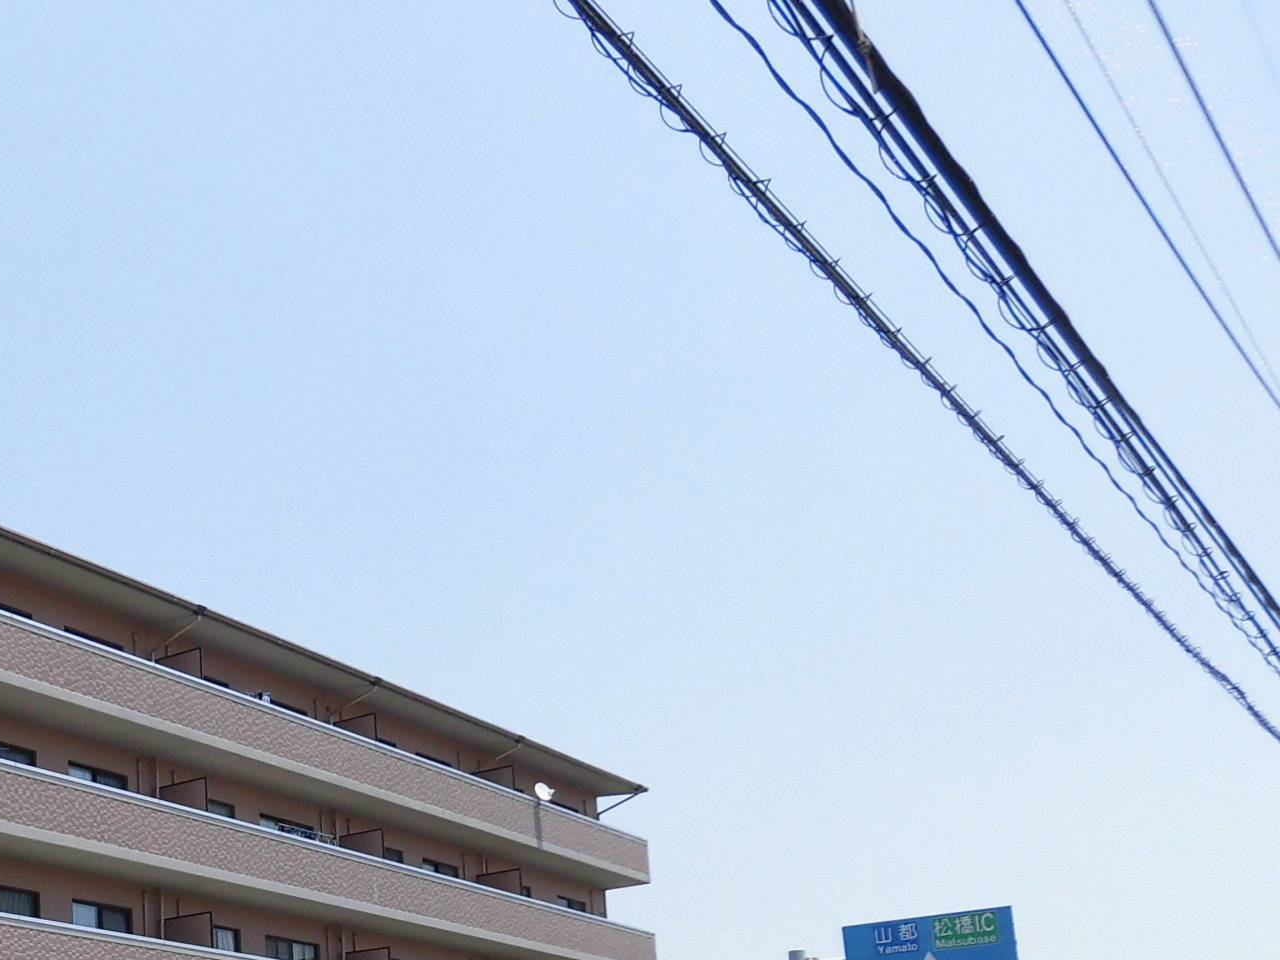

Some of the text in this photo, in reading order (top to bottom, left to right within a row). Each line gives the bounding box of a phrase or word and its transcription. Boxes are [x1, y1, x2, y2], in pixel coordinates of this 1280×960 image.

[874, 923, 918, 944] 山都
[934, 913, 995, 937] 松橋IC
[877, 944, 919, 955] Yamato
[935, 935, 998, 948] Matsubase
